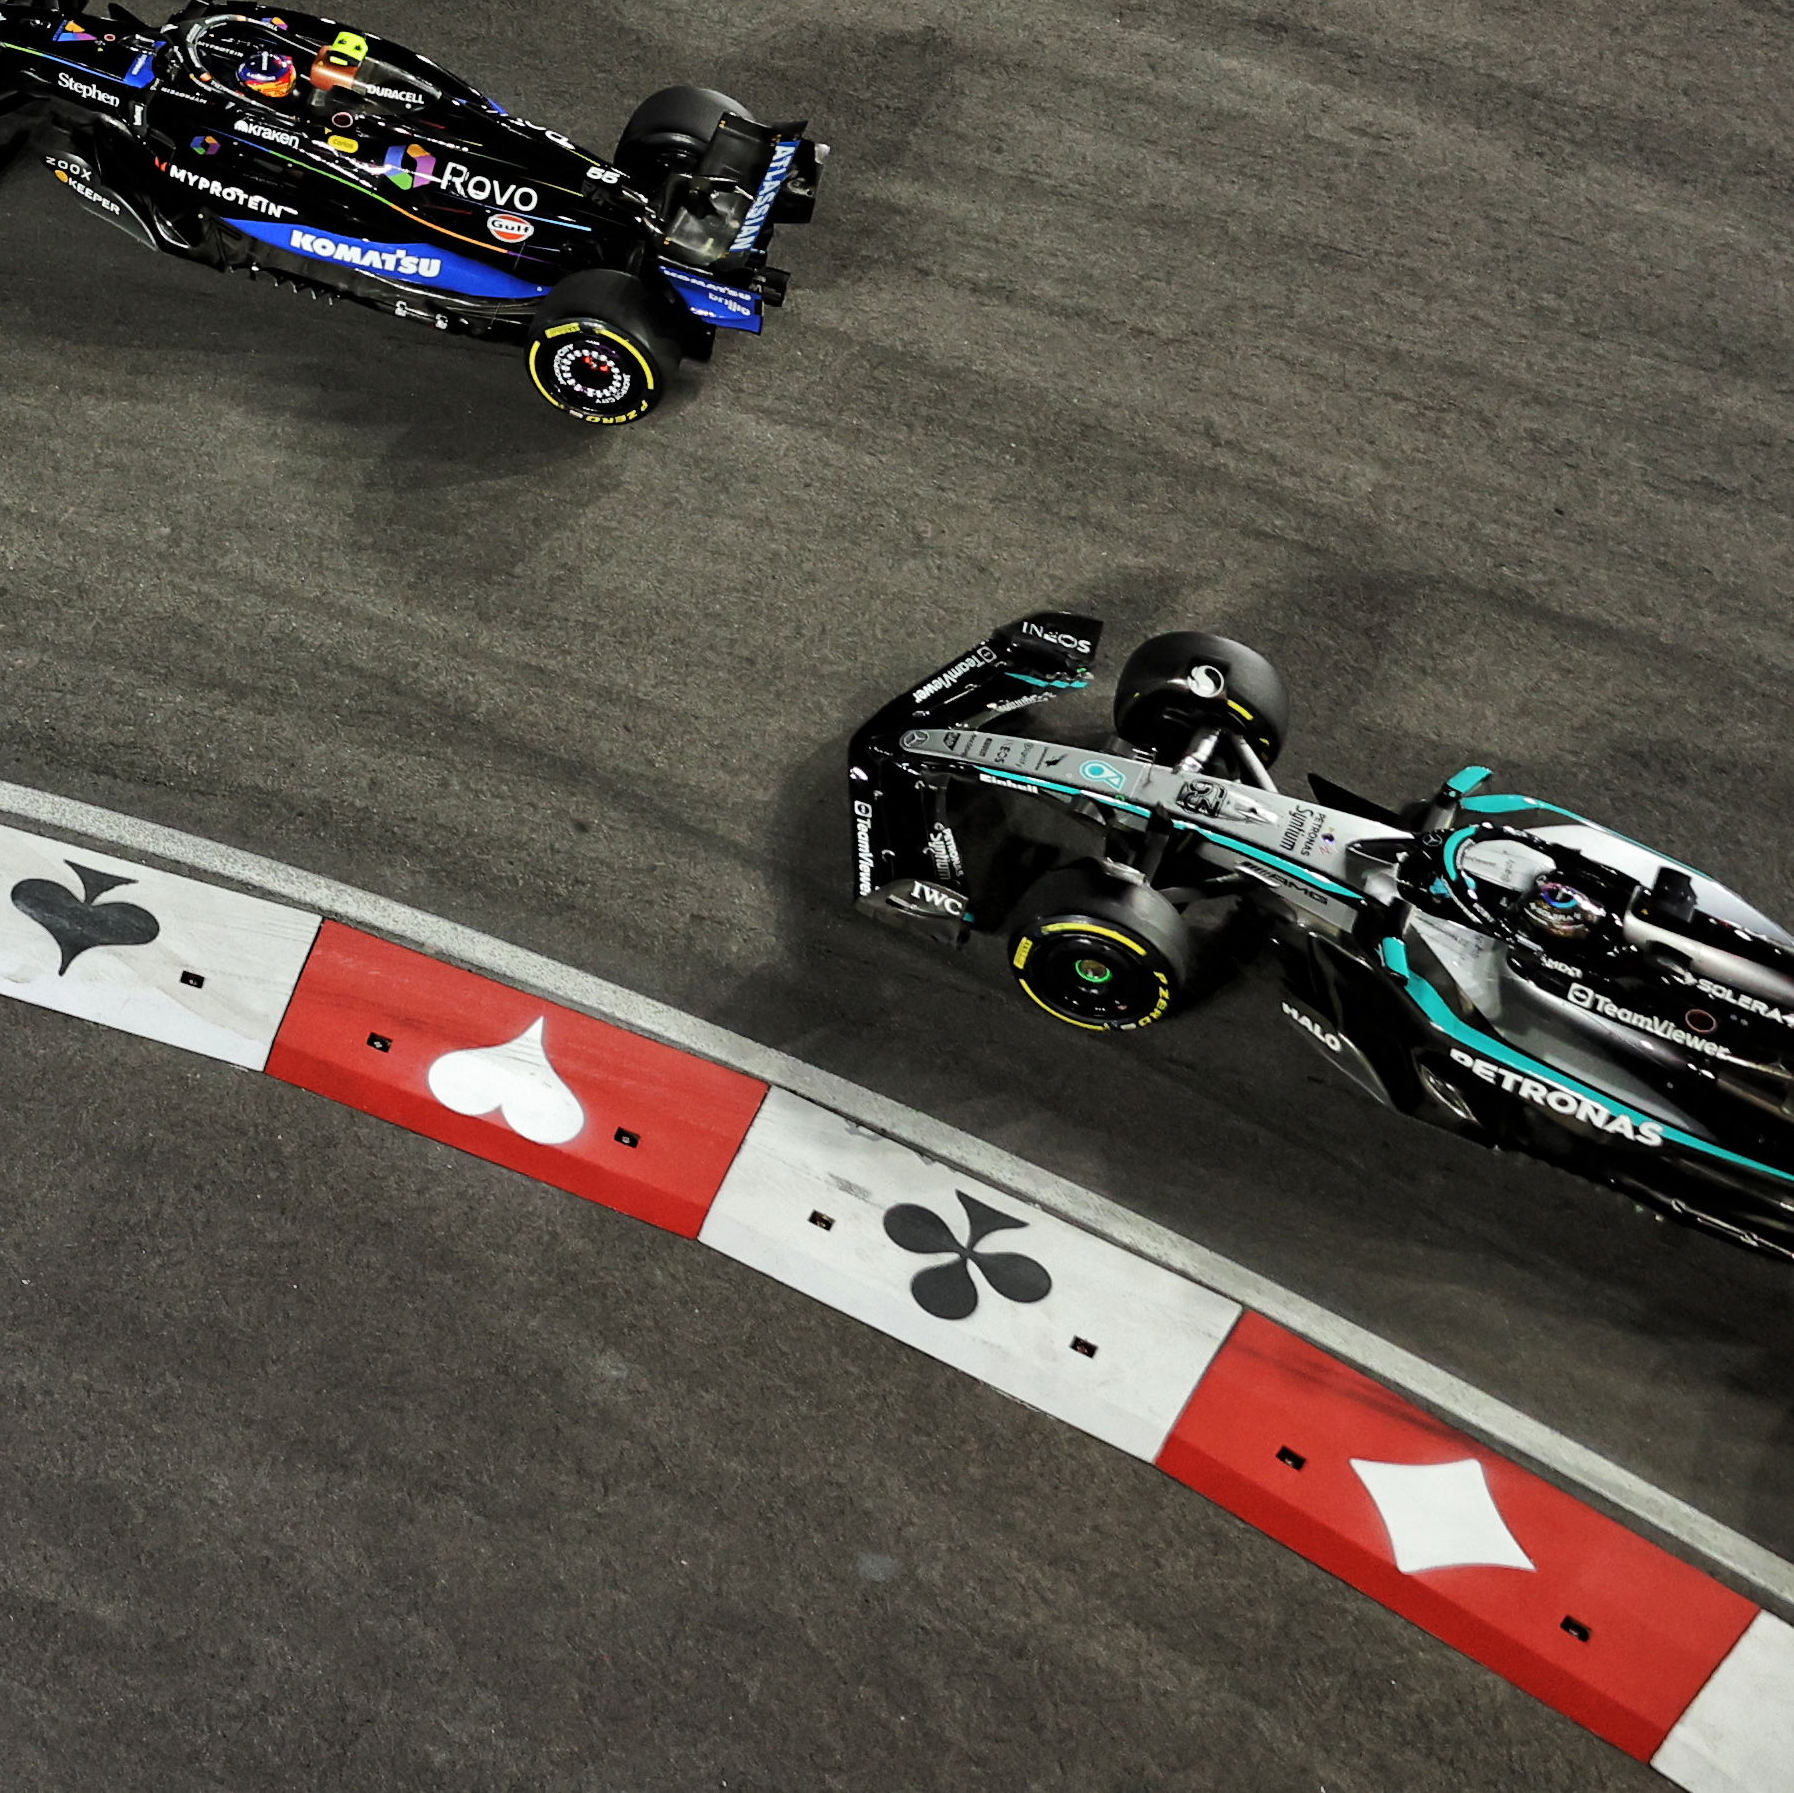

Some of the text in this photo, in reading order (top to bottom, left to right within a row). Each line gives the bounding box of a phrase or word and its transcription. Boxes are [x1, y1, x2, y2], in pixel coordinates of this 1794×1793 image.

[57, 72, 120, 108] Stephen
[366, 84, 424, 105] DURACELL
[46, 156, 93, 182] ZOOX
[169, 165, 284, 218] MYPROTEIN
[440, 162, 539, 212] ROVO
[585, 165, 621, 184] 55
[67, 177, 121, 216] KEEPER
[728, 145, 798, 253] ATLASSIAN
[491, 217, 530, 234] Gulf
[289, 229, 443, 278] KOMATSU
[585, 406, 639, 424] ZERO
[912, 653, 986, 703] TeamViewer
[979, 773, 1039, 794] Einhell
[1280, 804, 1313, 852] Syntium
[1301, 812, 1327, 857] PETRONAS
[855, 811, 875, 896] TeamViewe
[910, 880, 963, 915] IWC
[1594, 987, 1731, 1061] TeamViewer
[1697, 977, 1783, 1026] SOLERA
[1281, 1001, 1342, 1053] HALO
[1449, 1047, 1665, 1148] PETRONAS
